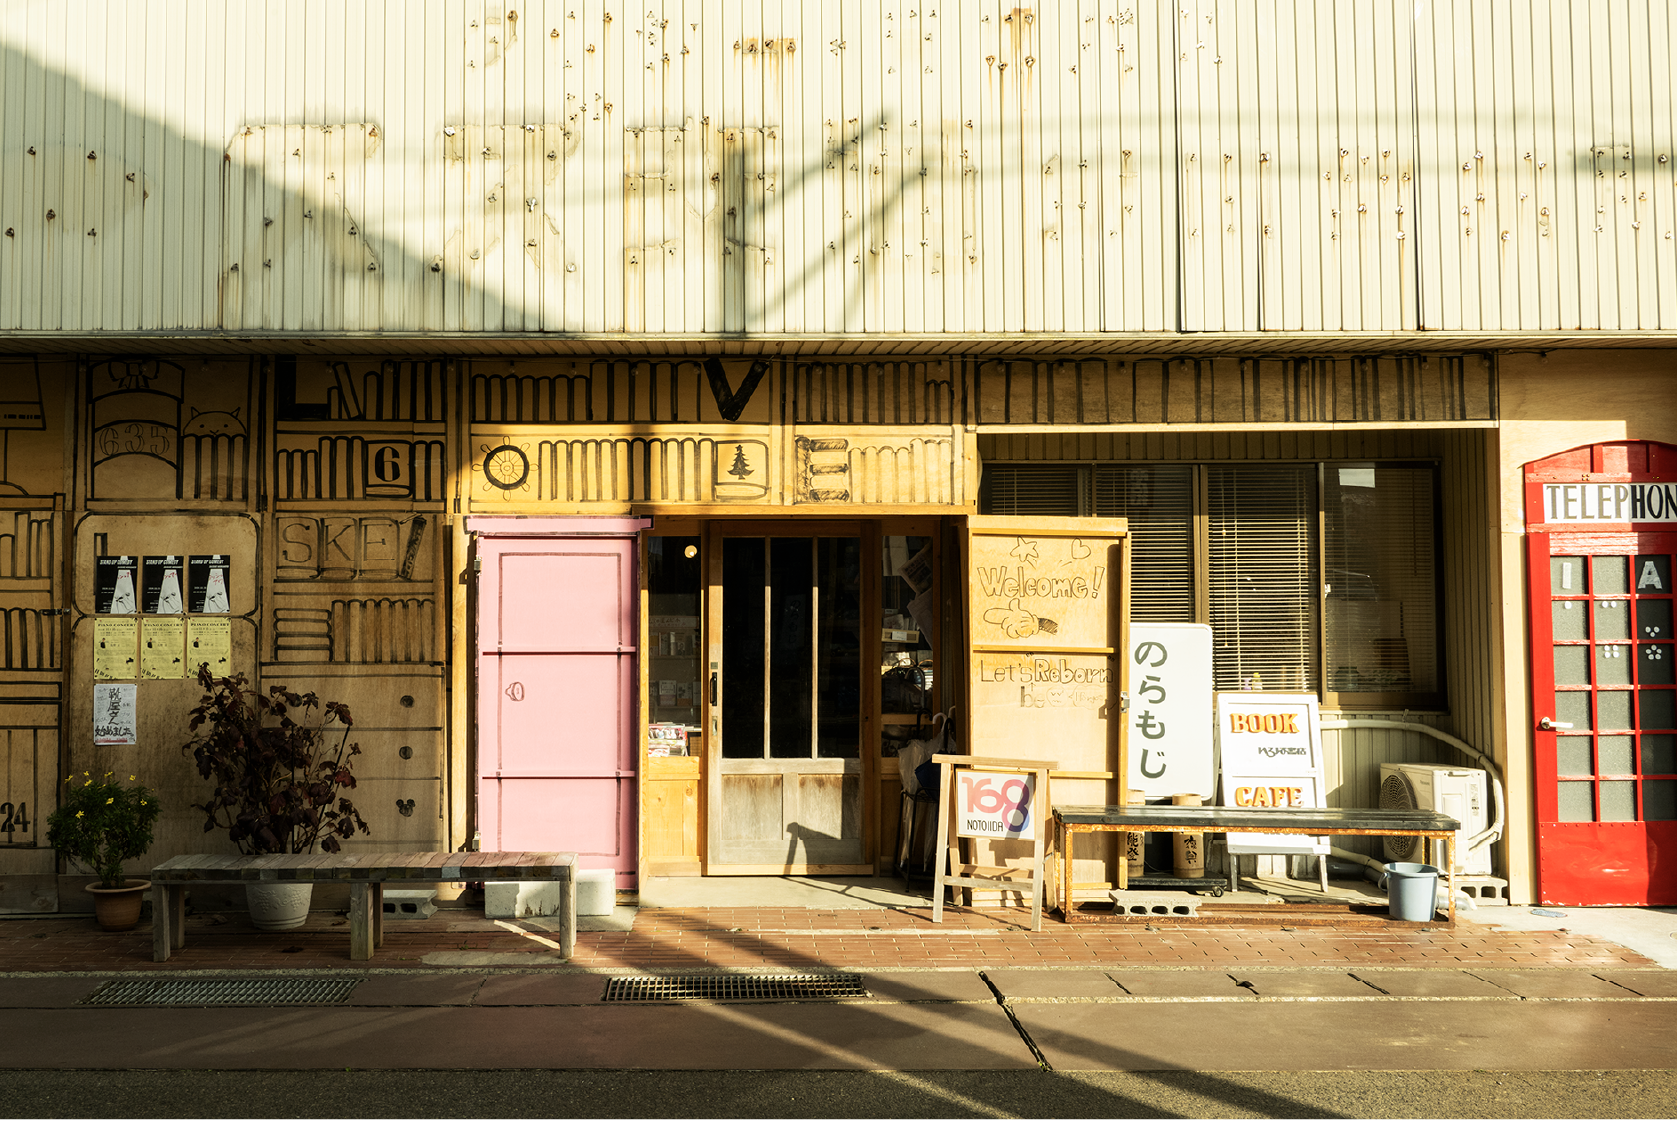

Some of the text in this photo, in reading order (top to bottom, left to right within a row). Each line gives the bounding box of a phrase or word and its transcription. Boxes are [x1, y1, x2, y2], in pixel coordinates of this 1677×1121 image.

[99, 422, 170, 457] 635
[374, 446, 401, 482] 6
[1637, 560, 1664, 590] A
[980, 659, 1032, 683] Let's
[1134, 641, 1168, 779] のらもじ
[1230, 712, 1300, 734] BOOK
[961, 776, 1030, 833] 168
[1235, 786, 1305, 808] CAFE
[0, 801, 31, 833] 24
